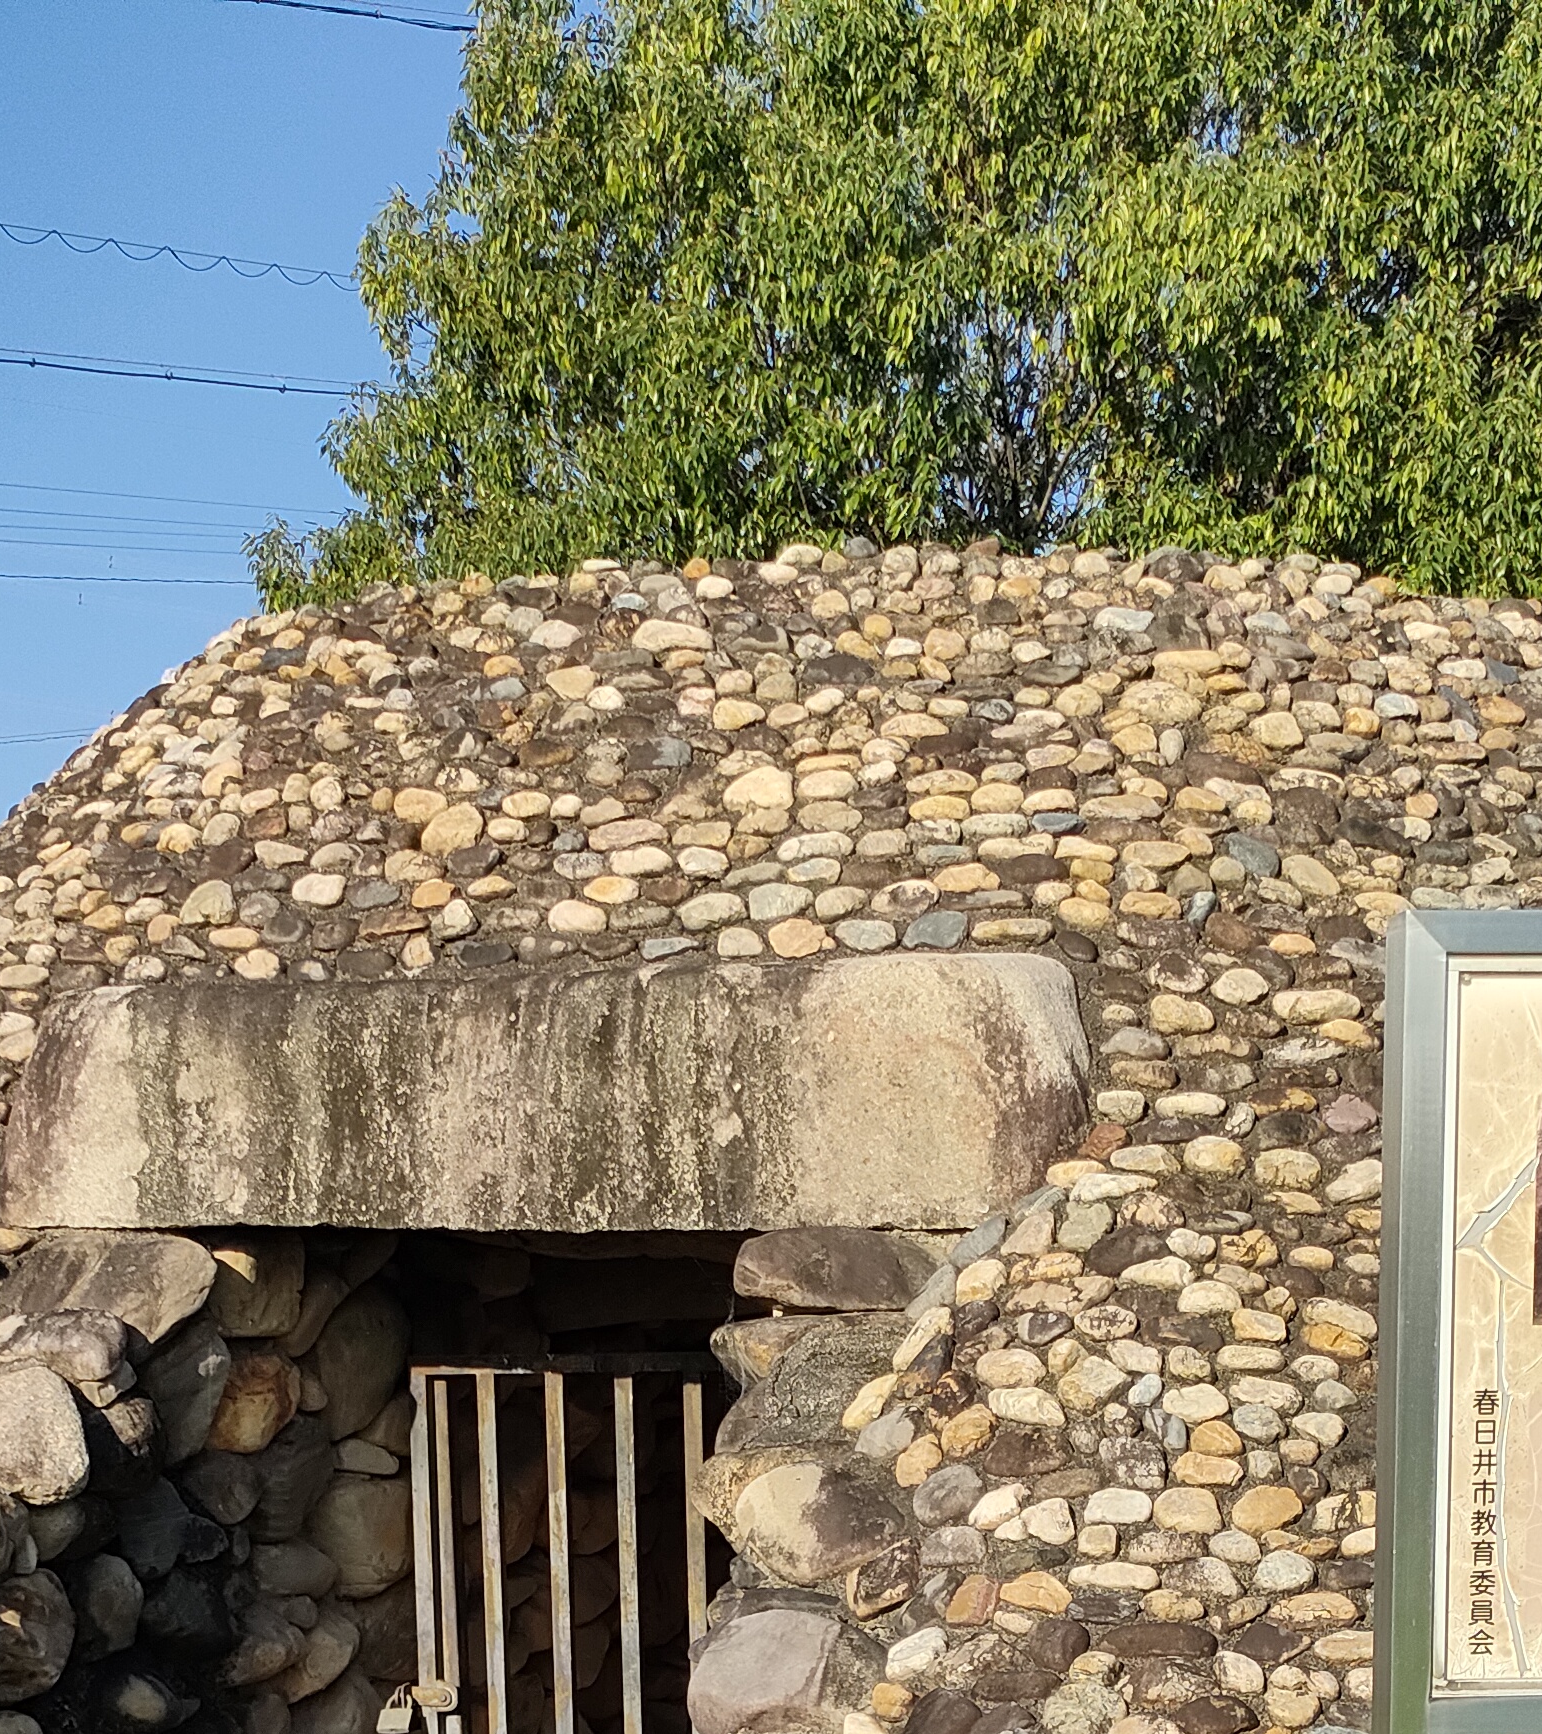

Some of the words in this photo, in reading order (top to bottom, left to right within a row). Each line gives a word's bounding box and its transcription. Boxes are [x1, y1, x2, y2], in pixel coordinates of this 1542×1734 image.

[1468, 1388, 1500, 1655] 春日井市教育委員会
